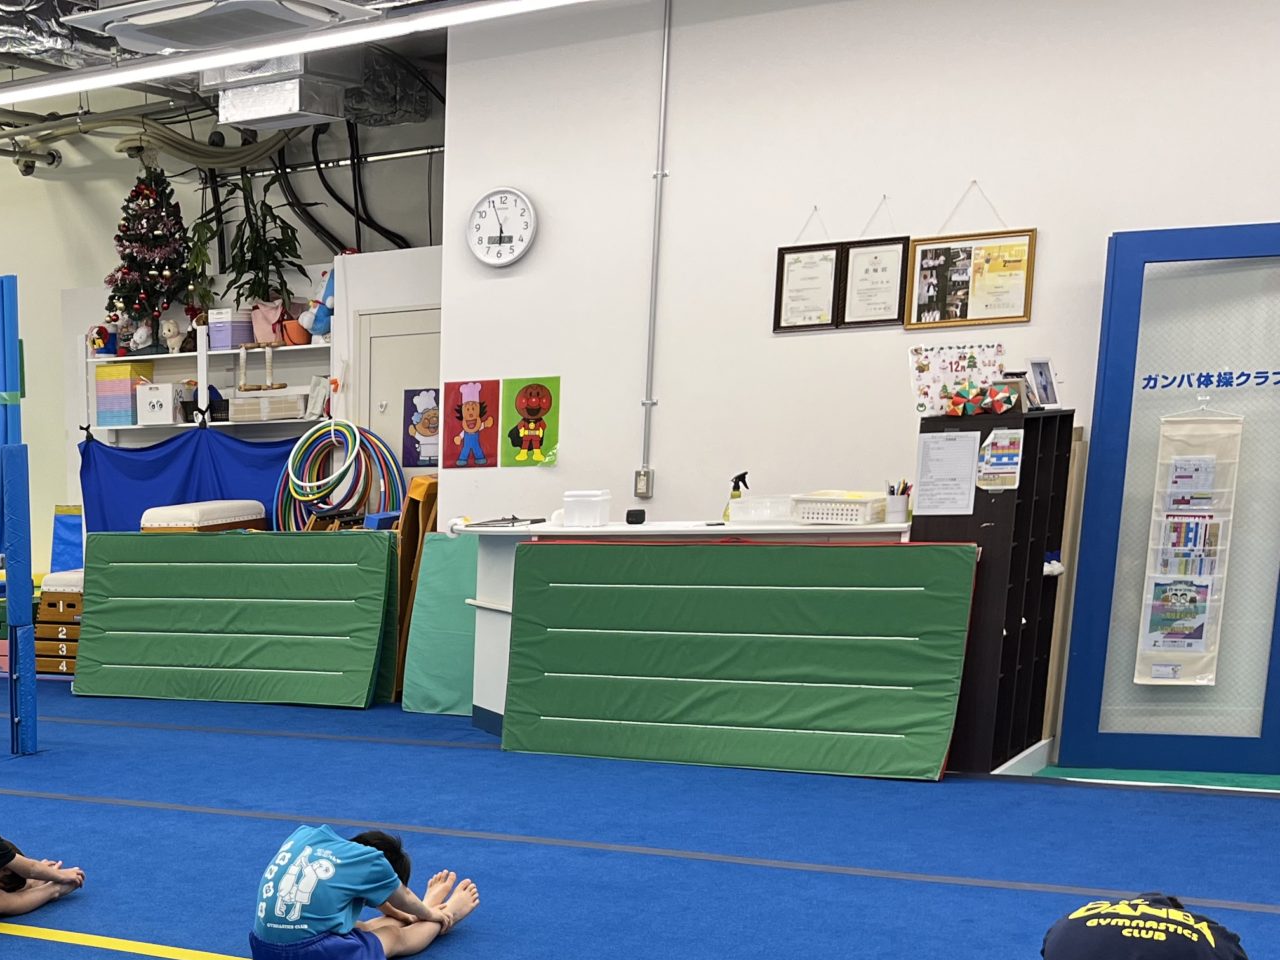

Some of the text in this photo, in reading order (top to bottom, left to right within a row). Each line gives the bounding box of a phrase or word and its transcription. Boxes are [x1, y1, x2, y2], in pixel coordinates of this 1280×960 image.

[500, 195, 508, 205] 12
[513, 198, 518, 208] 1
[477, 210, 487, 219] 10
[520, 208, 526, 217] 2
[474, 223, 481, 232] 9
[523, 221, 529, 230] 3
[477, 236, 484, 245] 8
[518, 234, 524, 243] 4
[485, 246, 491, 255] 7
[509, 245, 515, 254] 5
[496, 250, 502, 259] 6
[59, 600, 64, 613] 1
[58, 626, 67, 639] 2
[58, 643, 67, 656] 3
[58, 660, 67, 672] 4
[1068, 900, 1216, 949] GANBA
[1085, 917, 1199, 942] GYMNASTICS
[1121, 928, 1167, 942] CLUB
